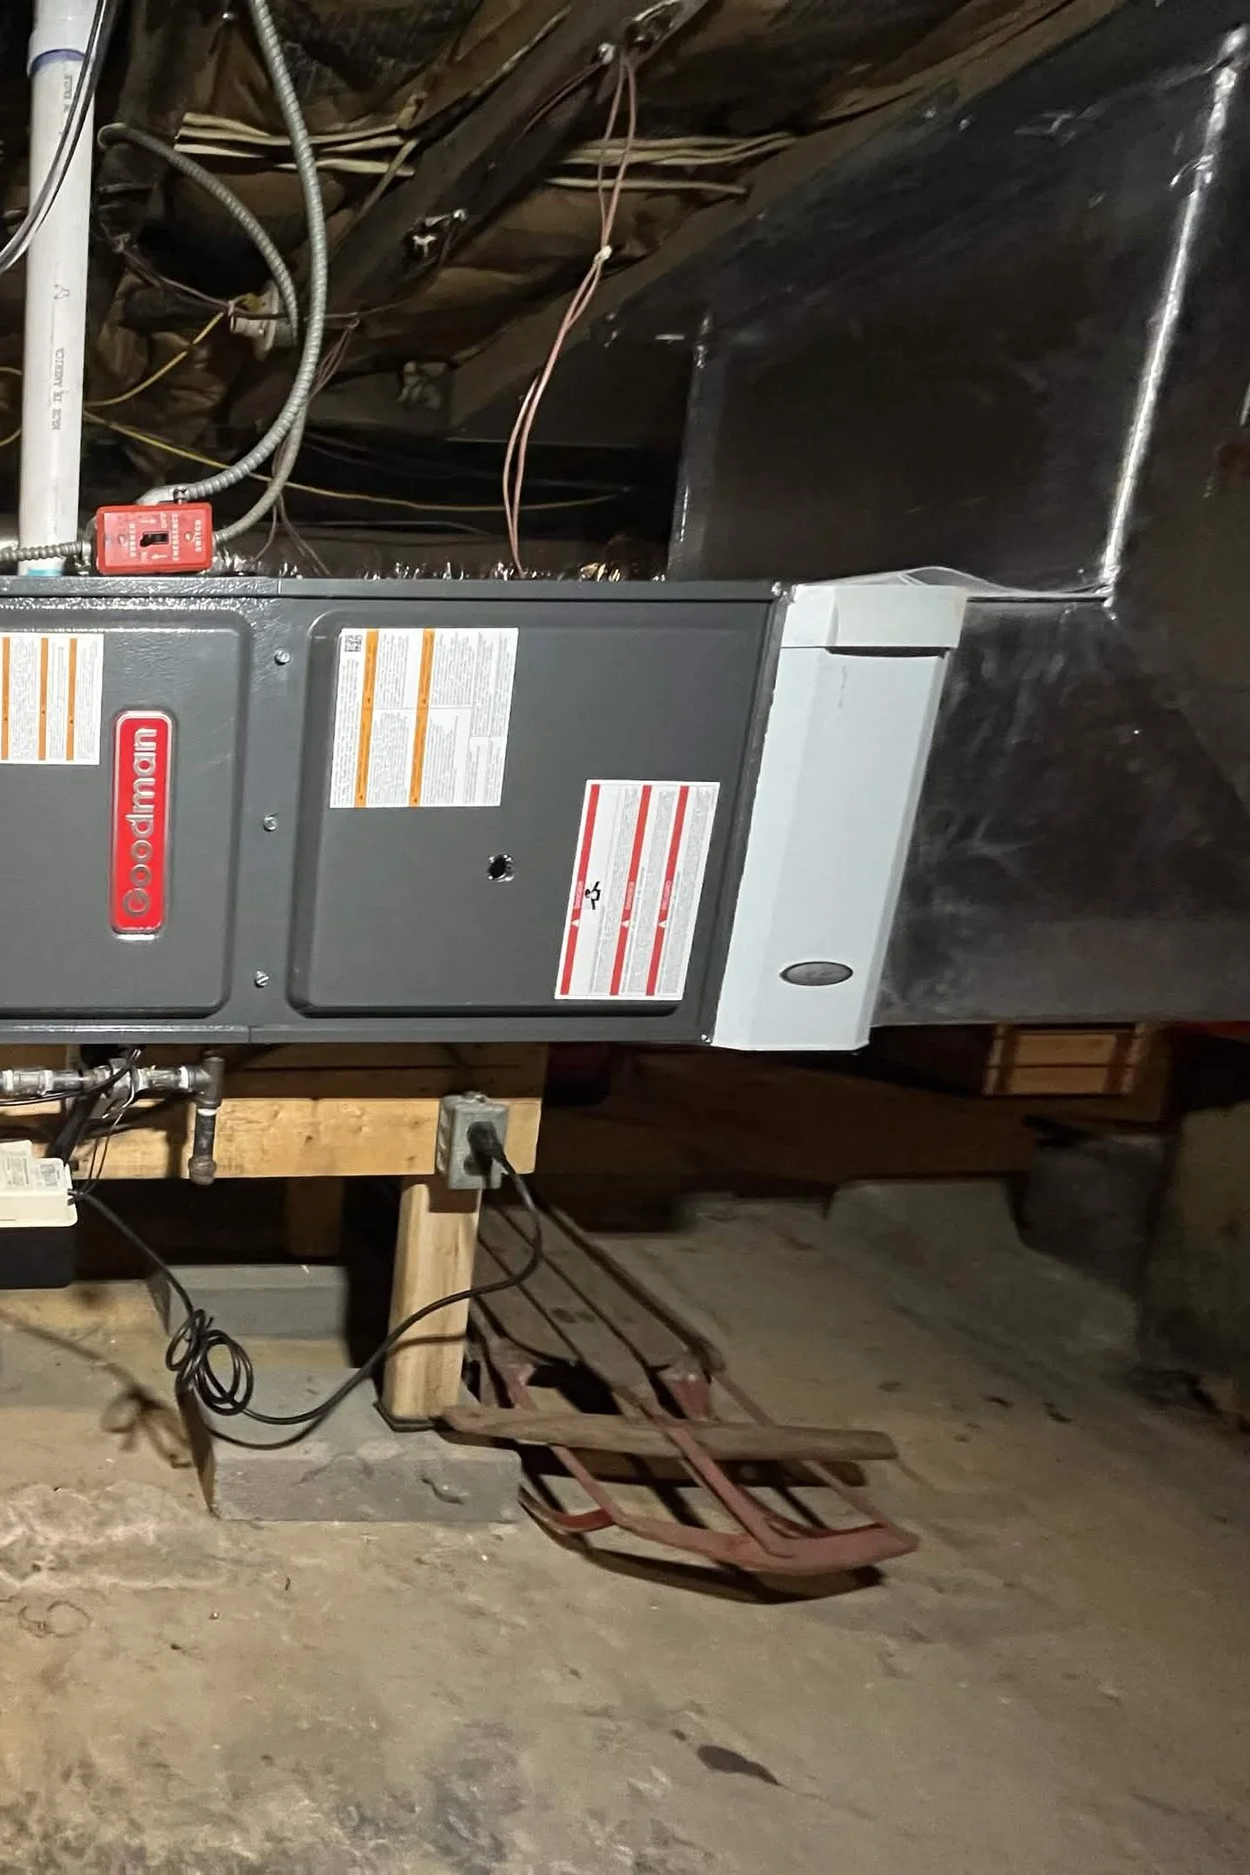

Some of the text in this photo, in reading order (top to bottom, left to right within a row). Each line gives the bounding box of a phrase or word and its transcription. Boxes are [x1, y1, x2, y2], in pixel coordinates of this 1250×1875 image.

[53, 347, 65, 388] AMERICA
[171, 513, 180, 562] EMERGENCY
[194, 519, 203, 552] SWITCH
[121, 726, 158, 918] Goodman
